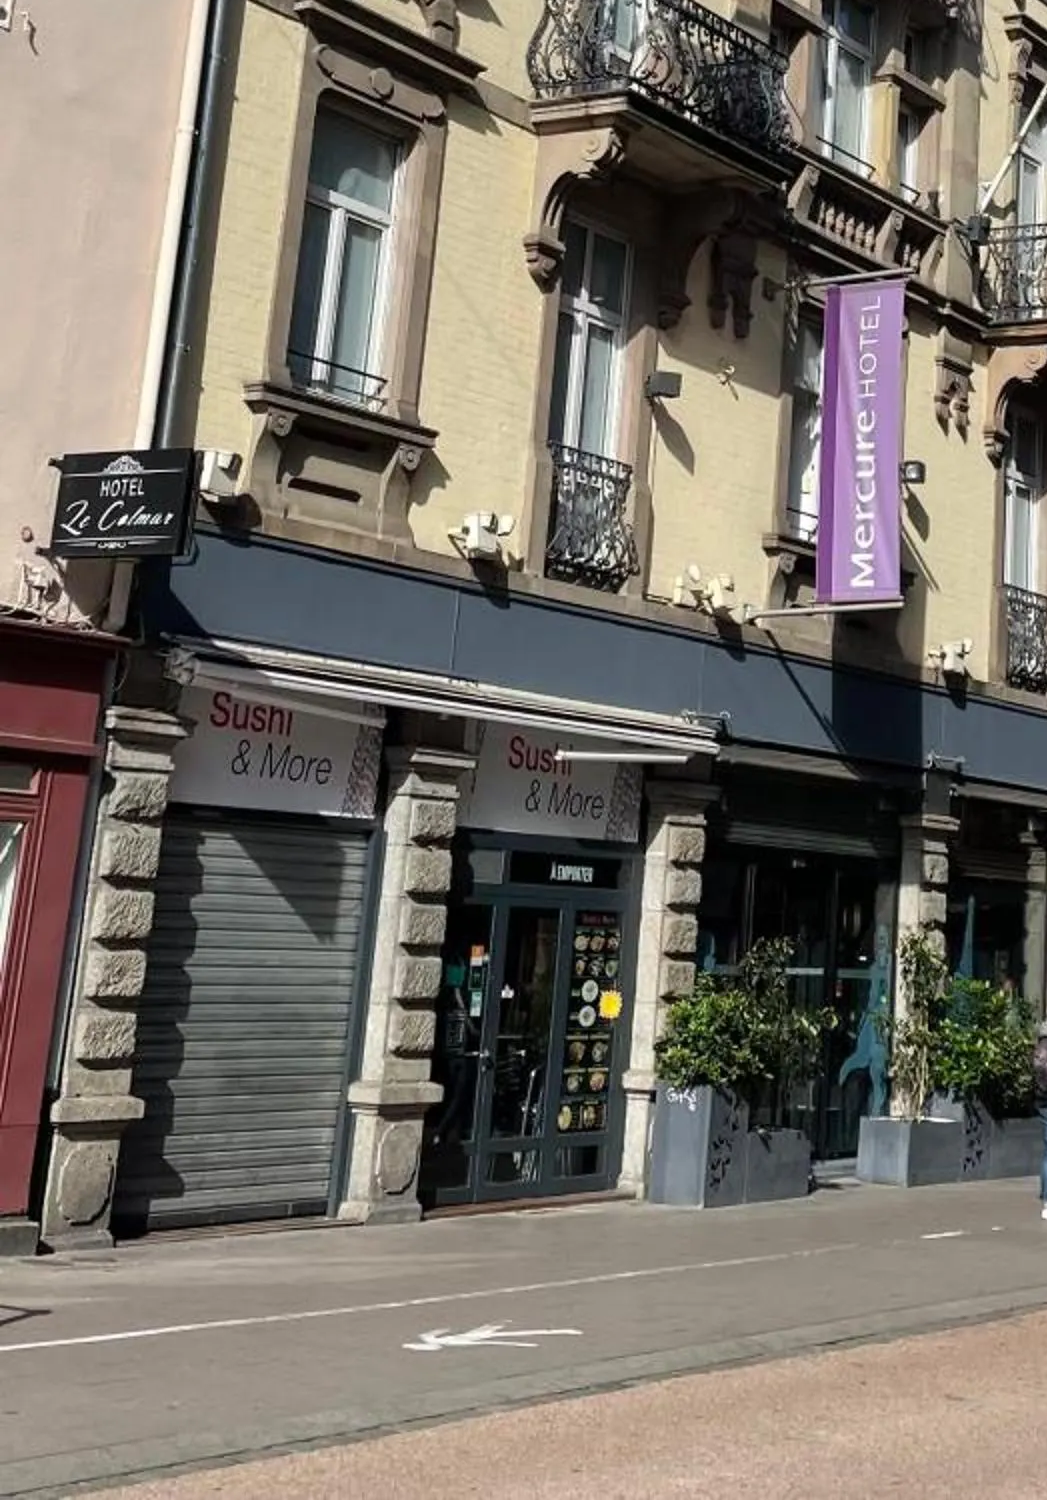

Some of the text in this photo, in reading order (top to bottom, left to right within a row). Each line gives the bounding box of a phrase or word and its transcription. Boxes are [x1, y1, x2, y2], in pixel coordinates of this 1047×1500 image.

[850, 294, 882, 589] Mercure HOTEL
[99, 477, 145, 497] HOTEL
[60, 499, 175, 536] Le Colmar
[210, 691, 294, 737] Sushi
[231, 739, 333, 785] & More
[508, 735, 574, 777] Sushi
[525, 779, 605, 820] & More
